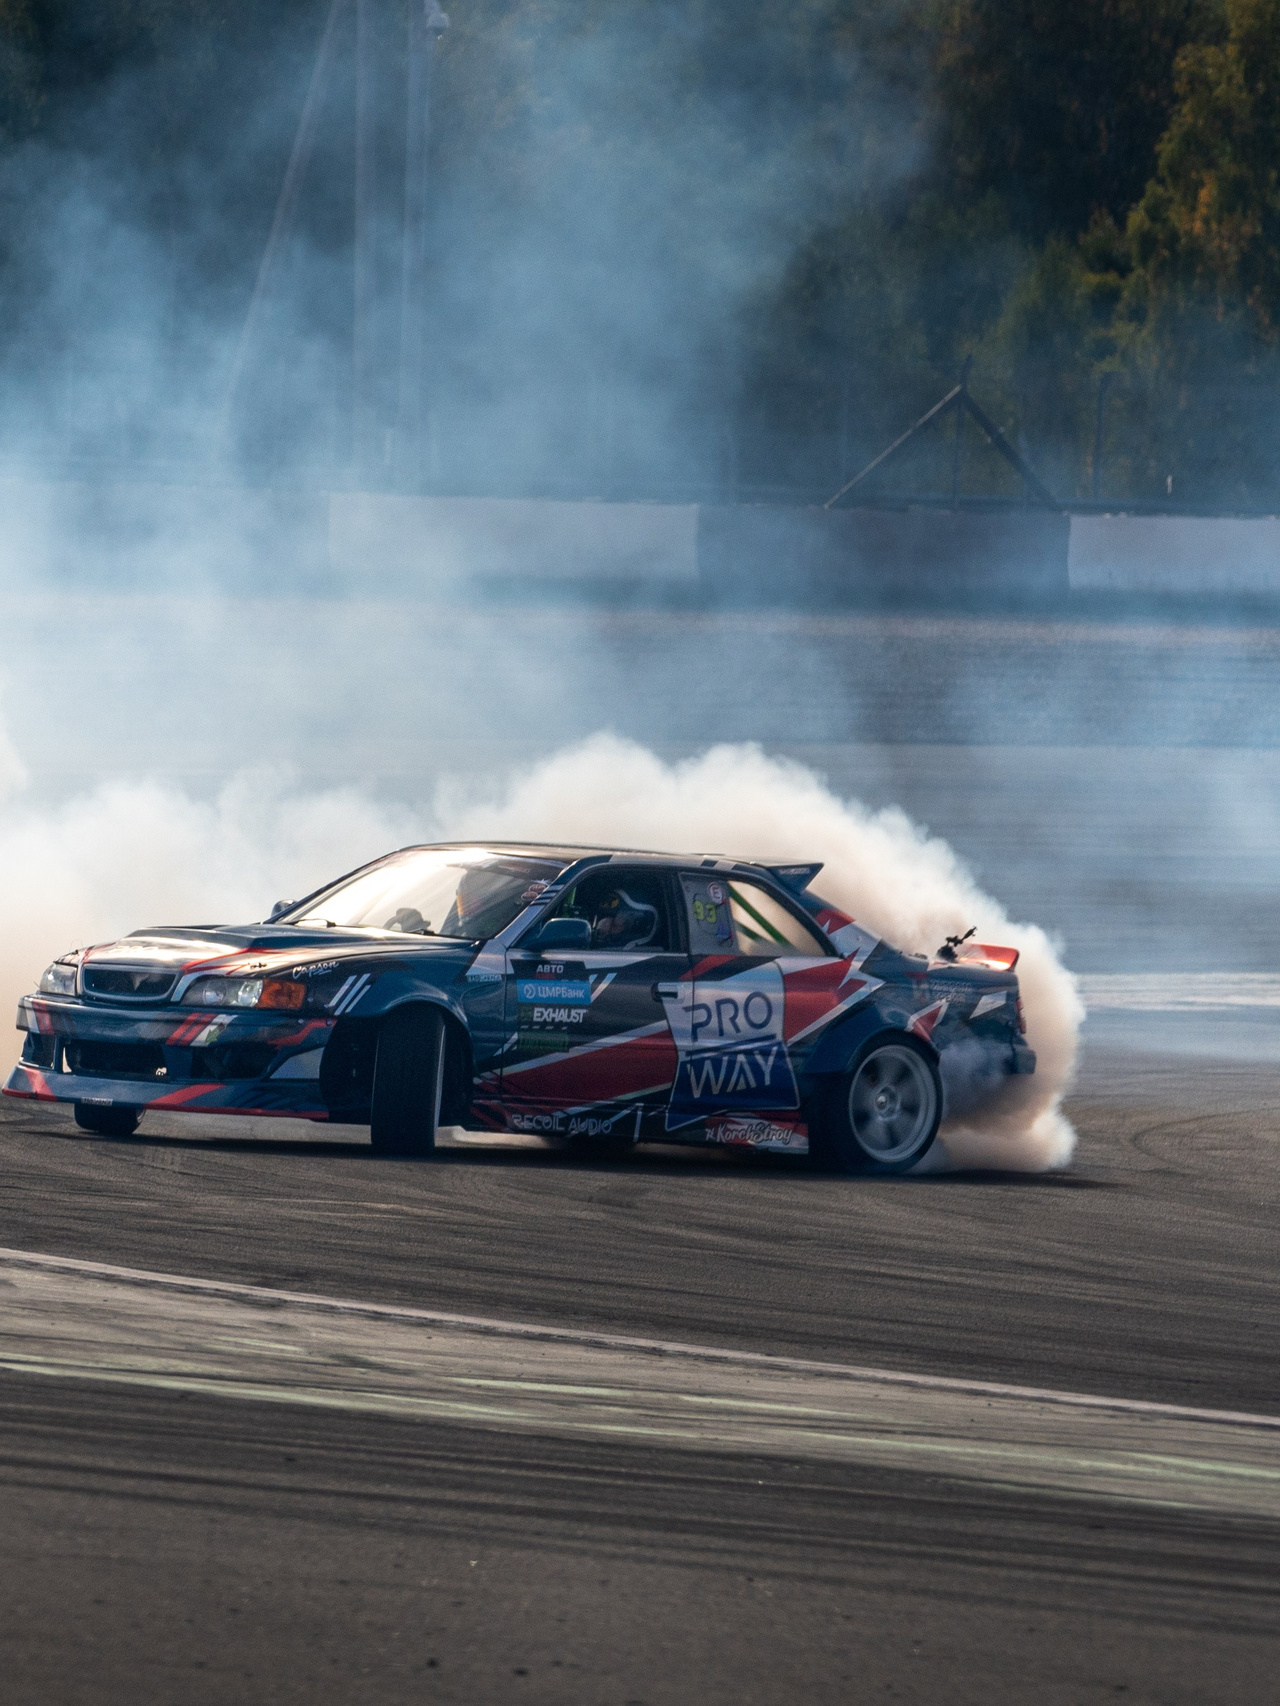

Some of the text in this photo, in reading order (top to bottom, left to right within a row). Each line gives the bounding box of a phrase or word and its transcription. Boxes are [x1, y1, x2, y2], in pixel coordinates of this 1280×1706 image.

[693, 900, 717, 924] 93
[535, 964, 564, 973] АВТО
[538, 986, 585, 999] ЦМРБанк
[533, 1007, 588, 1023] EXHAUST
[682, 991, 773, 1042] PRO
[686, 1046, 779, 1099] WAY
[512, 1113, 612, 1136] RECOIL AUDIO
[716, 1122, 794, 1145] KorchStroy
